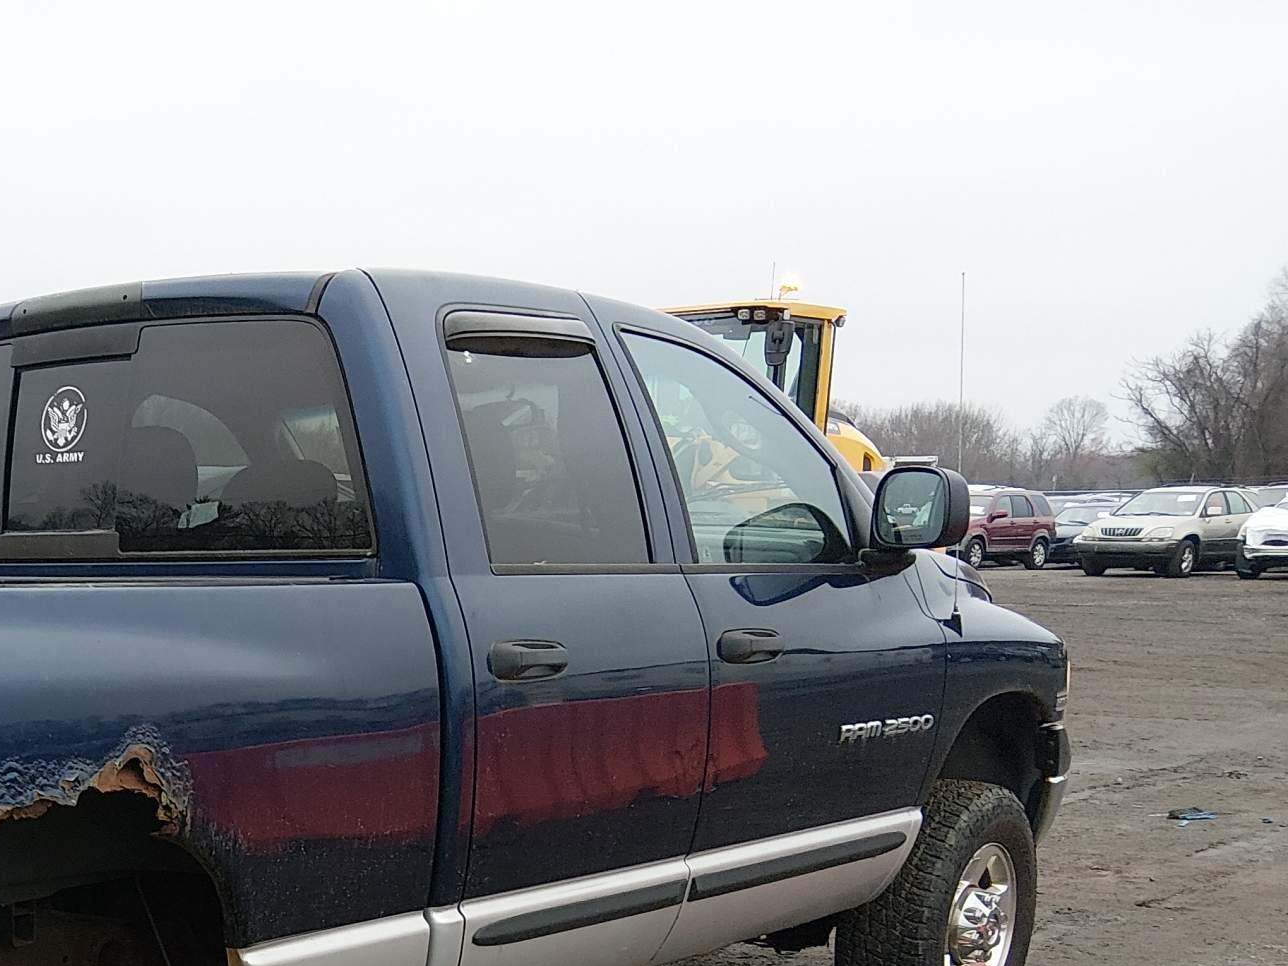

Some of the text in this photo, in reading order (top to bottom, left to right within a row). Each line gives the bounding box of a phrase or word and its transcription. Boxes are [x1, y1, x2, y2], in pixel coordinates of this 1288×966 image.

[36, 452, 84, 464] U.S. ARMY
[840, 714, 934, 742] RAM 2500
